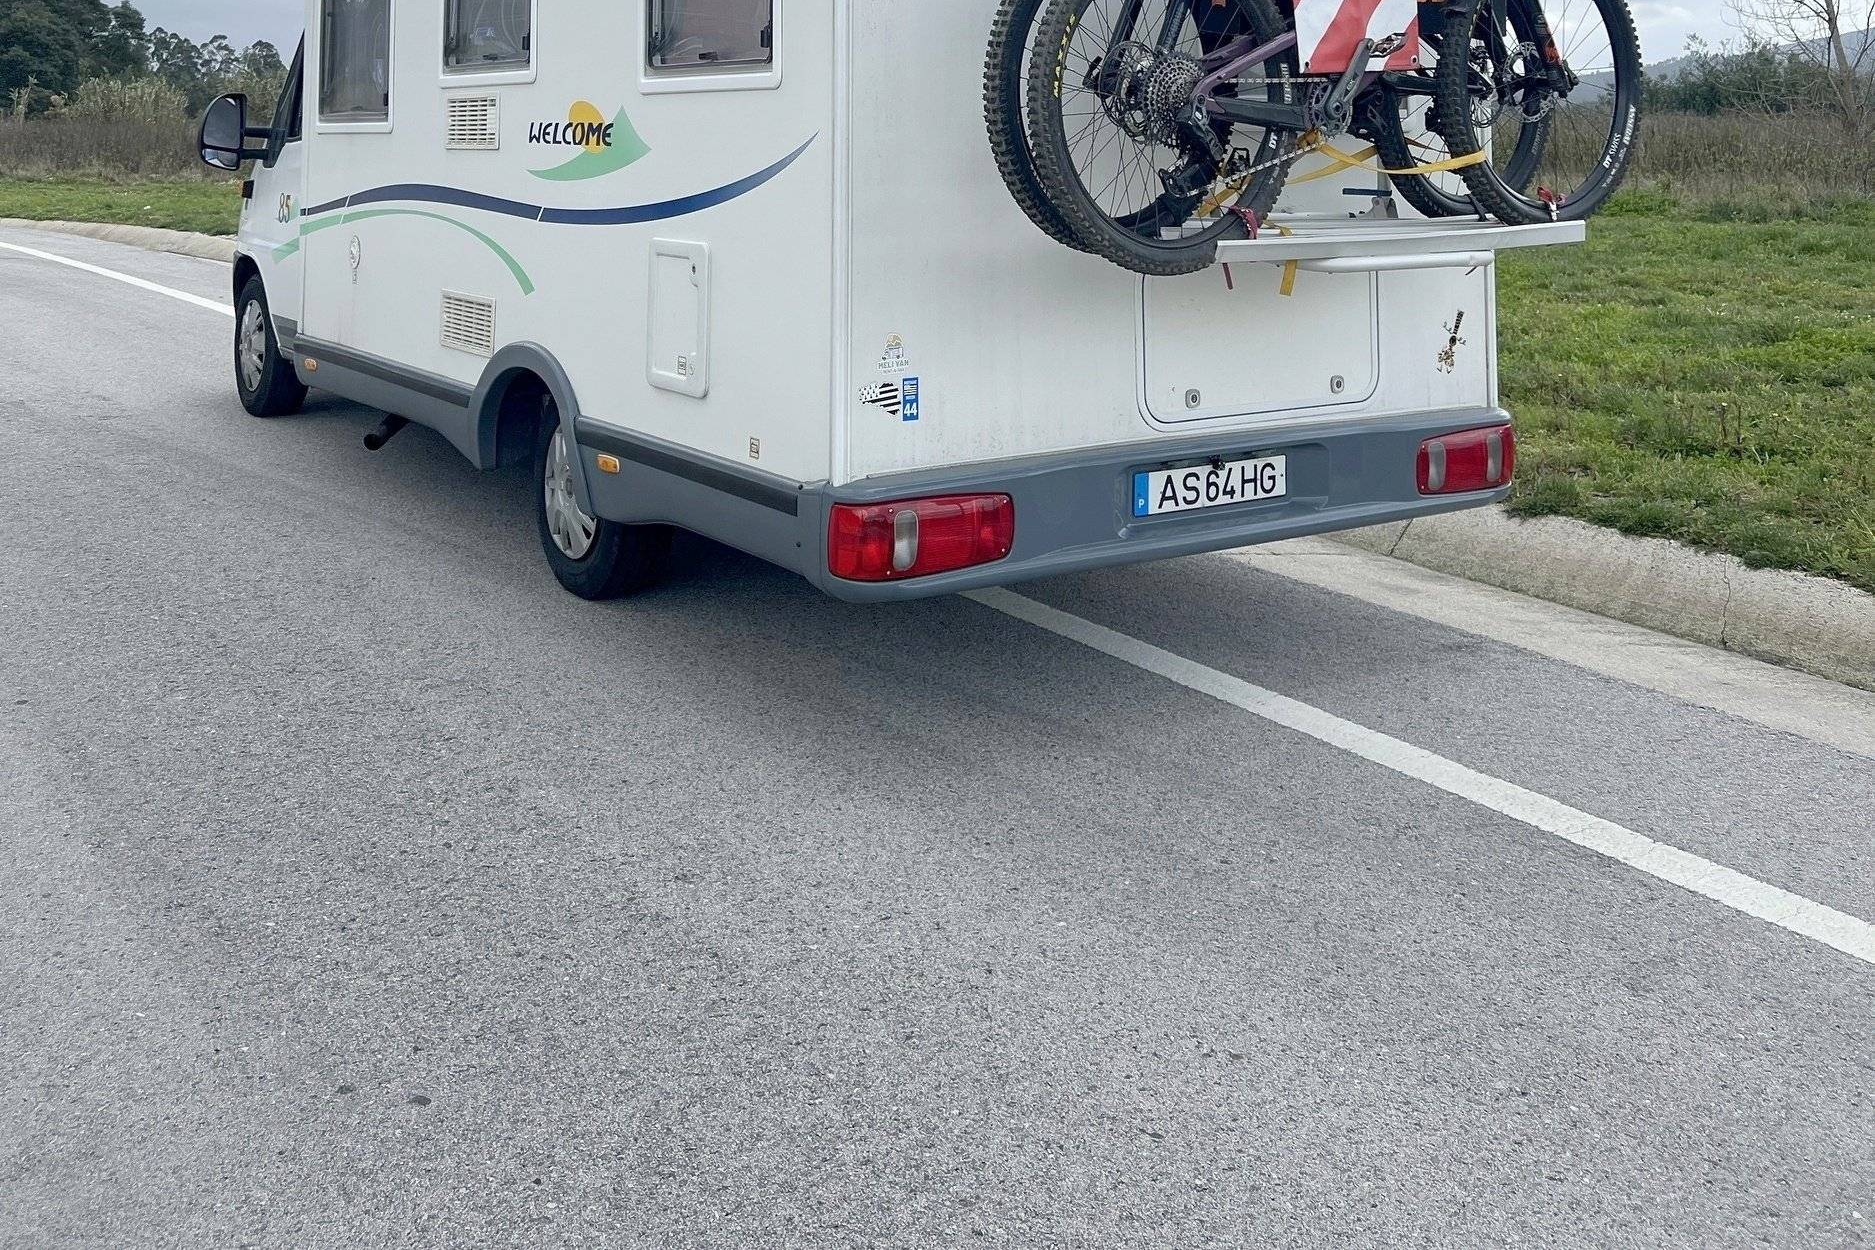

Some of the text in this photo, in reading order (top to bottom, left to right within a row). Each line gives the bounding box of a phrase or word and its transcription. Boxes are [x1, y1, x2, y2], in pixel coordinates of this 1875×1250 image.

[1052, 13, 1077, 98] MAXXIS
[528, 121, 614, 147] WELCOME
[1603, 132, 1621, 169] DT SWISS
[278, 192, 291, 224] 85
[904, 402, 918, 417] 44
[1138, 499, 1145, 509] P
